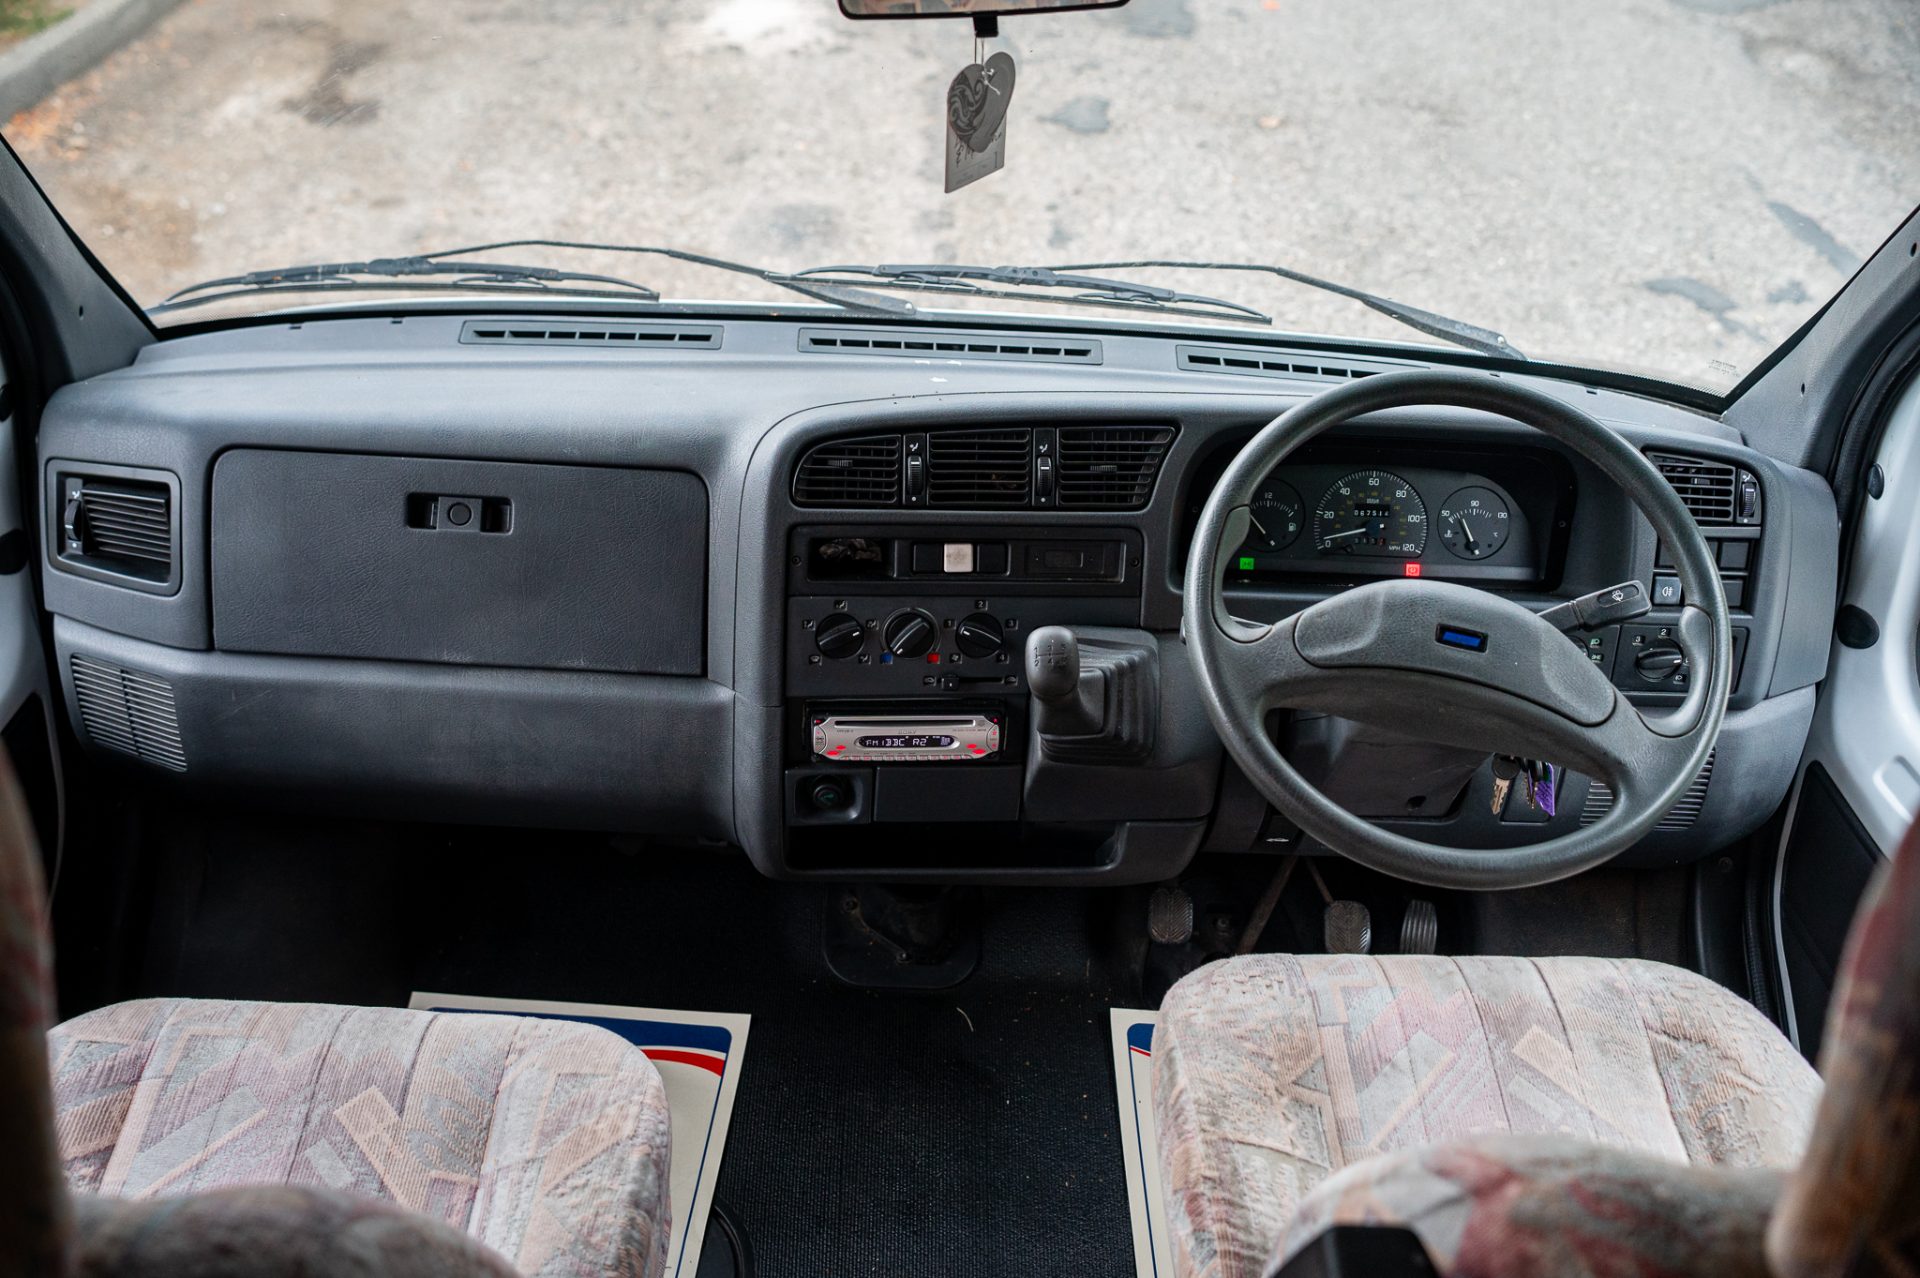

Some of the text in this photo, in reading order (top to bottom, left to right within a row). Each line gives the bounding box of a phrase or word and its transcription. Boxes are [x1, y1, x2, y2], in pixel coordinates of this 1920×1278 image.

[1368, 478, 1380, 486] 60
[1339, 487, 1351, 495] 40
[1395, 490, 1407, 498] 80
[1323, 511, 1335, 519] 20
[1407, 514, 1421, 522] 100
[1324, 540, 1332, 548] 0
[1402, 543, 1415, 551] 120
[912, 738, 927, 747] R2
